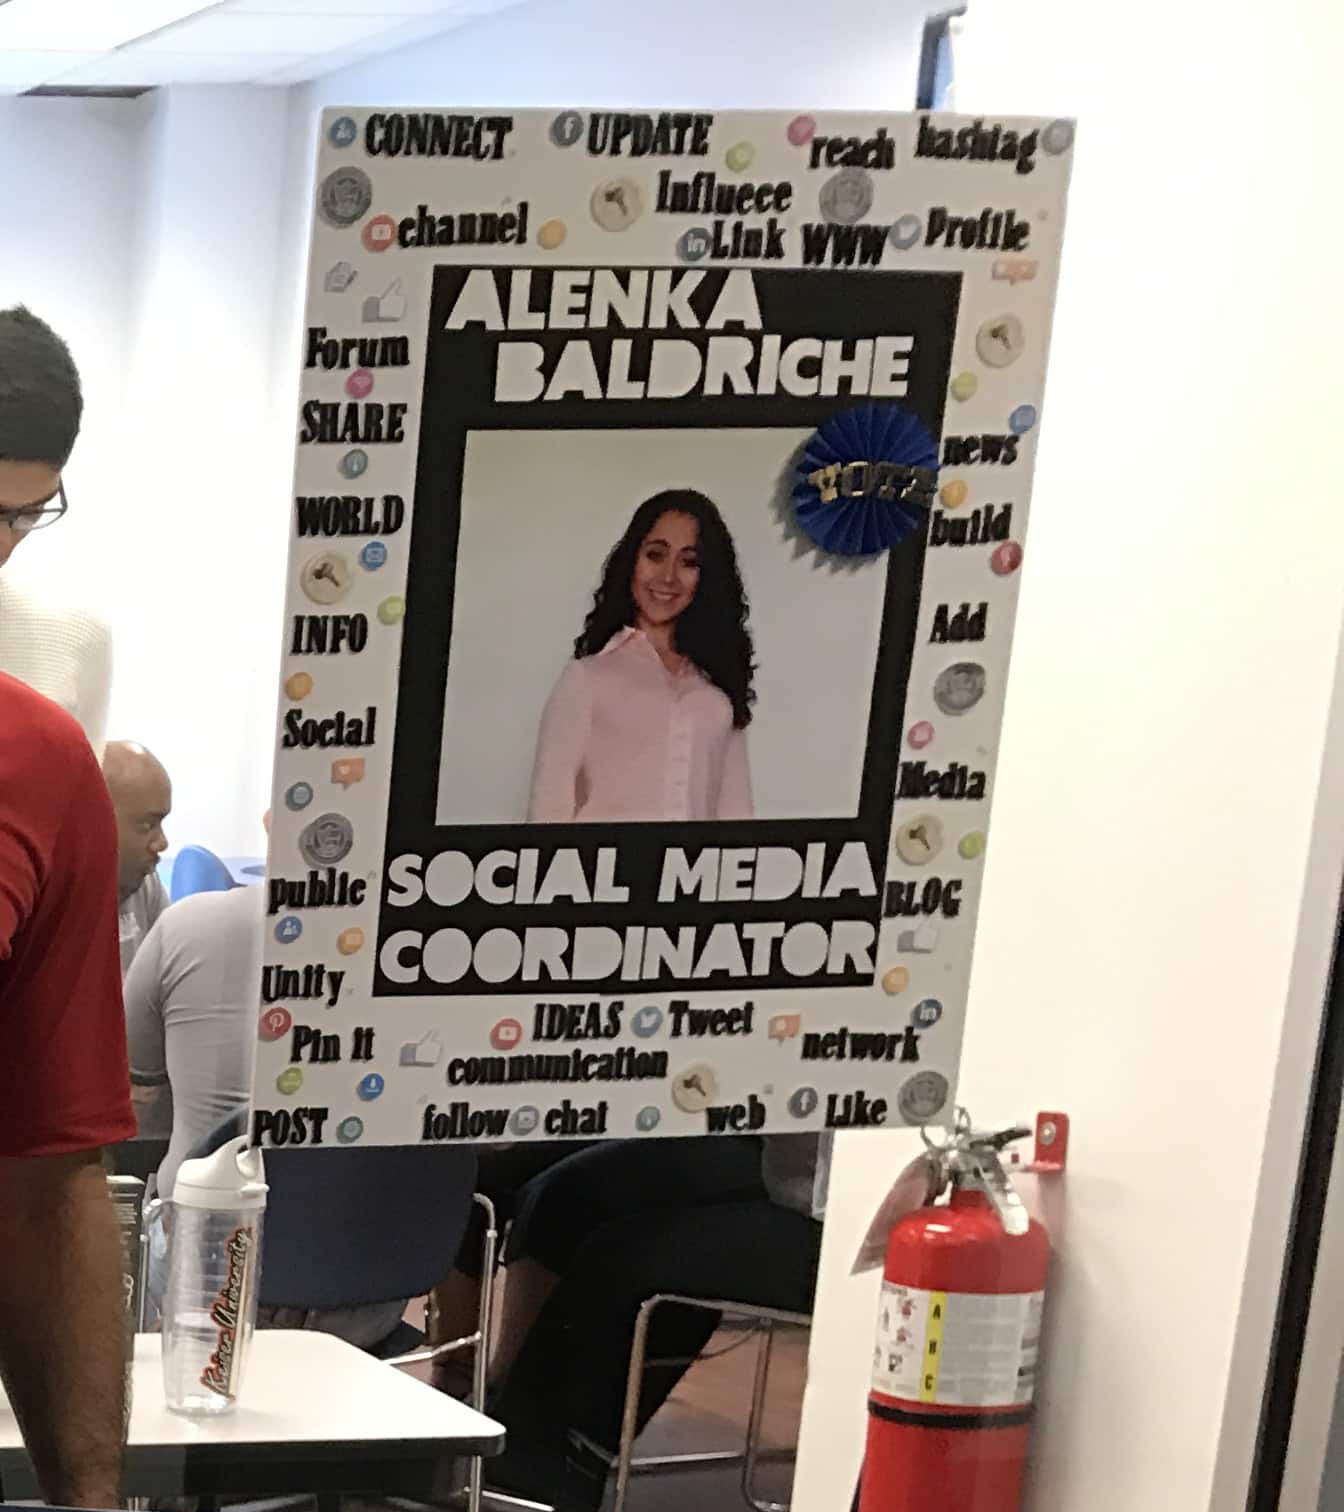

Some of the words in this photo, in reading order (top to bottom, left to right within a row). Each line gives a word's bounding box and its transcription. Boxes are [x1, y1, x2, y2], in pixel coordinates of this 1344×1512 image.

[365, 112, 514, 161] CONNECT
[586, 112, 714, 156] UPDATE
[808, 127, 896, 170] reach
[914, 115, 1040, 175] hashtag
[397, 201, 529, 248] channel
[709, 217, 787, 259] Link
[923, 206, 1031, 252] Profile
[443, 267, 764, 332] ALENKA
[305, 327, 411, 369] Forum
[494, 333, 915, 404] BALDRICHE
[299, 399, 408, 444] SHARE
[943, 433, 1021, 469] news
[295, 494, 405, 538] WORLD
[927, 502, 1014, 548] build
[289, 613, 369, 656] INFO
[928, 602, 989, 646] Add
[281, 706, 377, 750] Social
[898, 761, 987, 803] Media
[267, 867, 368, 916] public
[387, 845, 630, 908] SOCIAL
[657, 840, 880, 904] MEDIA
[884, 876, 964, 921] BLOG
[378, 919, 877, 985] COORDINATOR
[261, 963, 346, 1010] Unity
[531, 1000, 625, 1042] IDEAS
[668, 999, 755, 1039] Tweet
[289, 1025, 343, 1065] Pin
[799, 1025, 921, 1063] network
[446, 1047, 670, 1087] communication
[250, 1105, 329, 1148] POST
[421, 1100, 511, 1142] follow
[544, 1099, 609, 1136] chat
[705, 1093, 767, 1134] web
[824, 1090, 889, 1129] Like
[212, 1227, 252, 1329] University
[932, 1304, 941, 1320] A
[202, 1331, 233, 1396] Keiser
